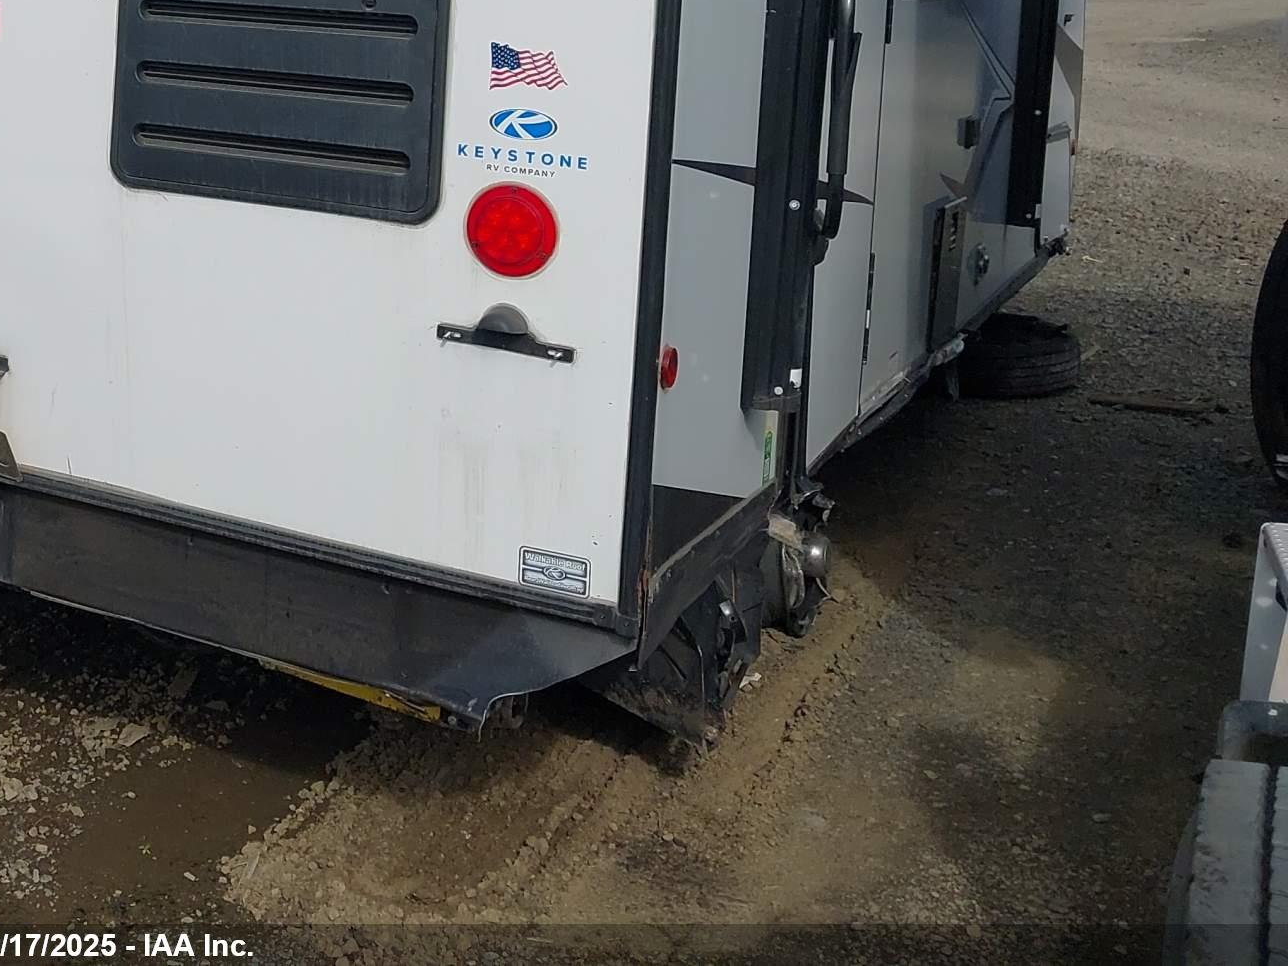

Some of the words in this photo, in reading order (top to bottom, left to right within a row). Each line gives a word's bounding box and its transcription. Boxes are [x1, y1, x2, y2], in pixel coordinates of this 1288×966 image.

[457, 143, 588, 170] KEYSTONE
[486, 163, 500, 172] RV
[503, 165, 556, 178] COMPANY
[524, 551, 565, 568] Walkable
[566, 560, 586, 572] Roof
